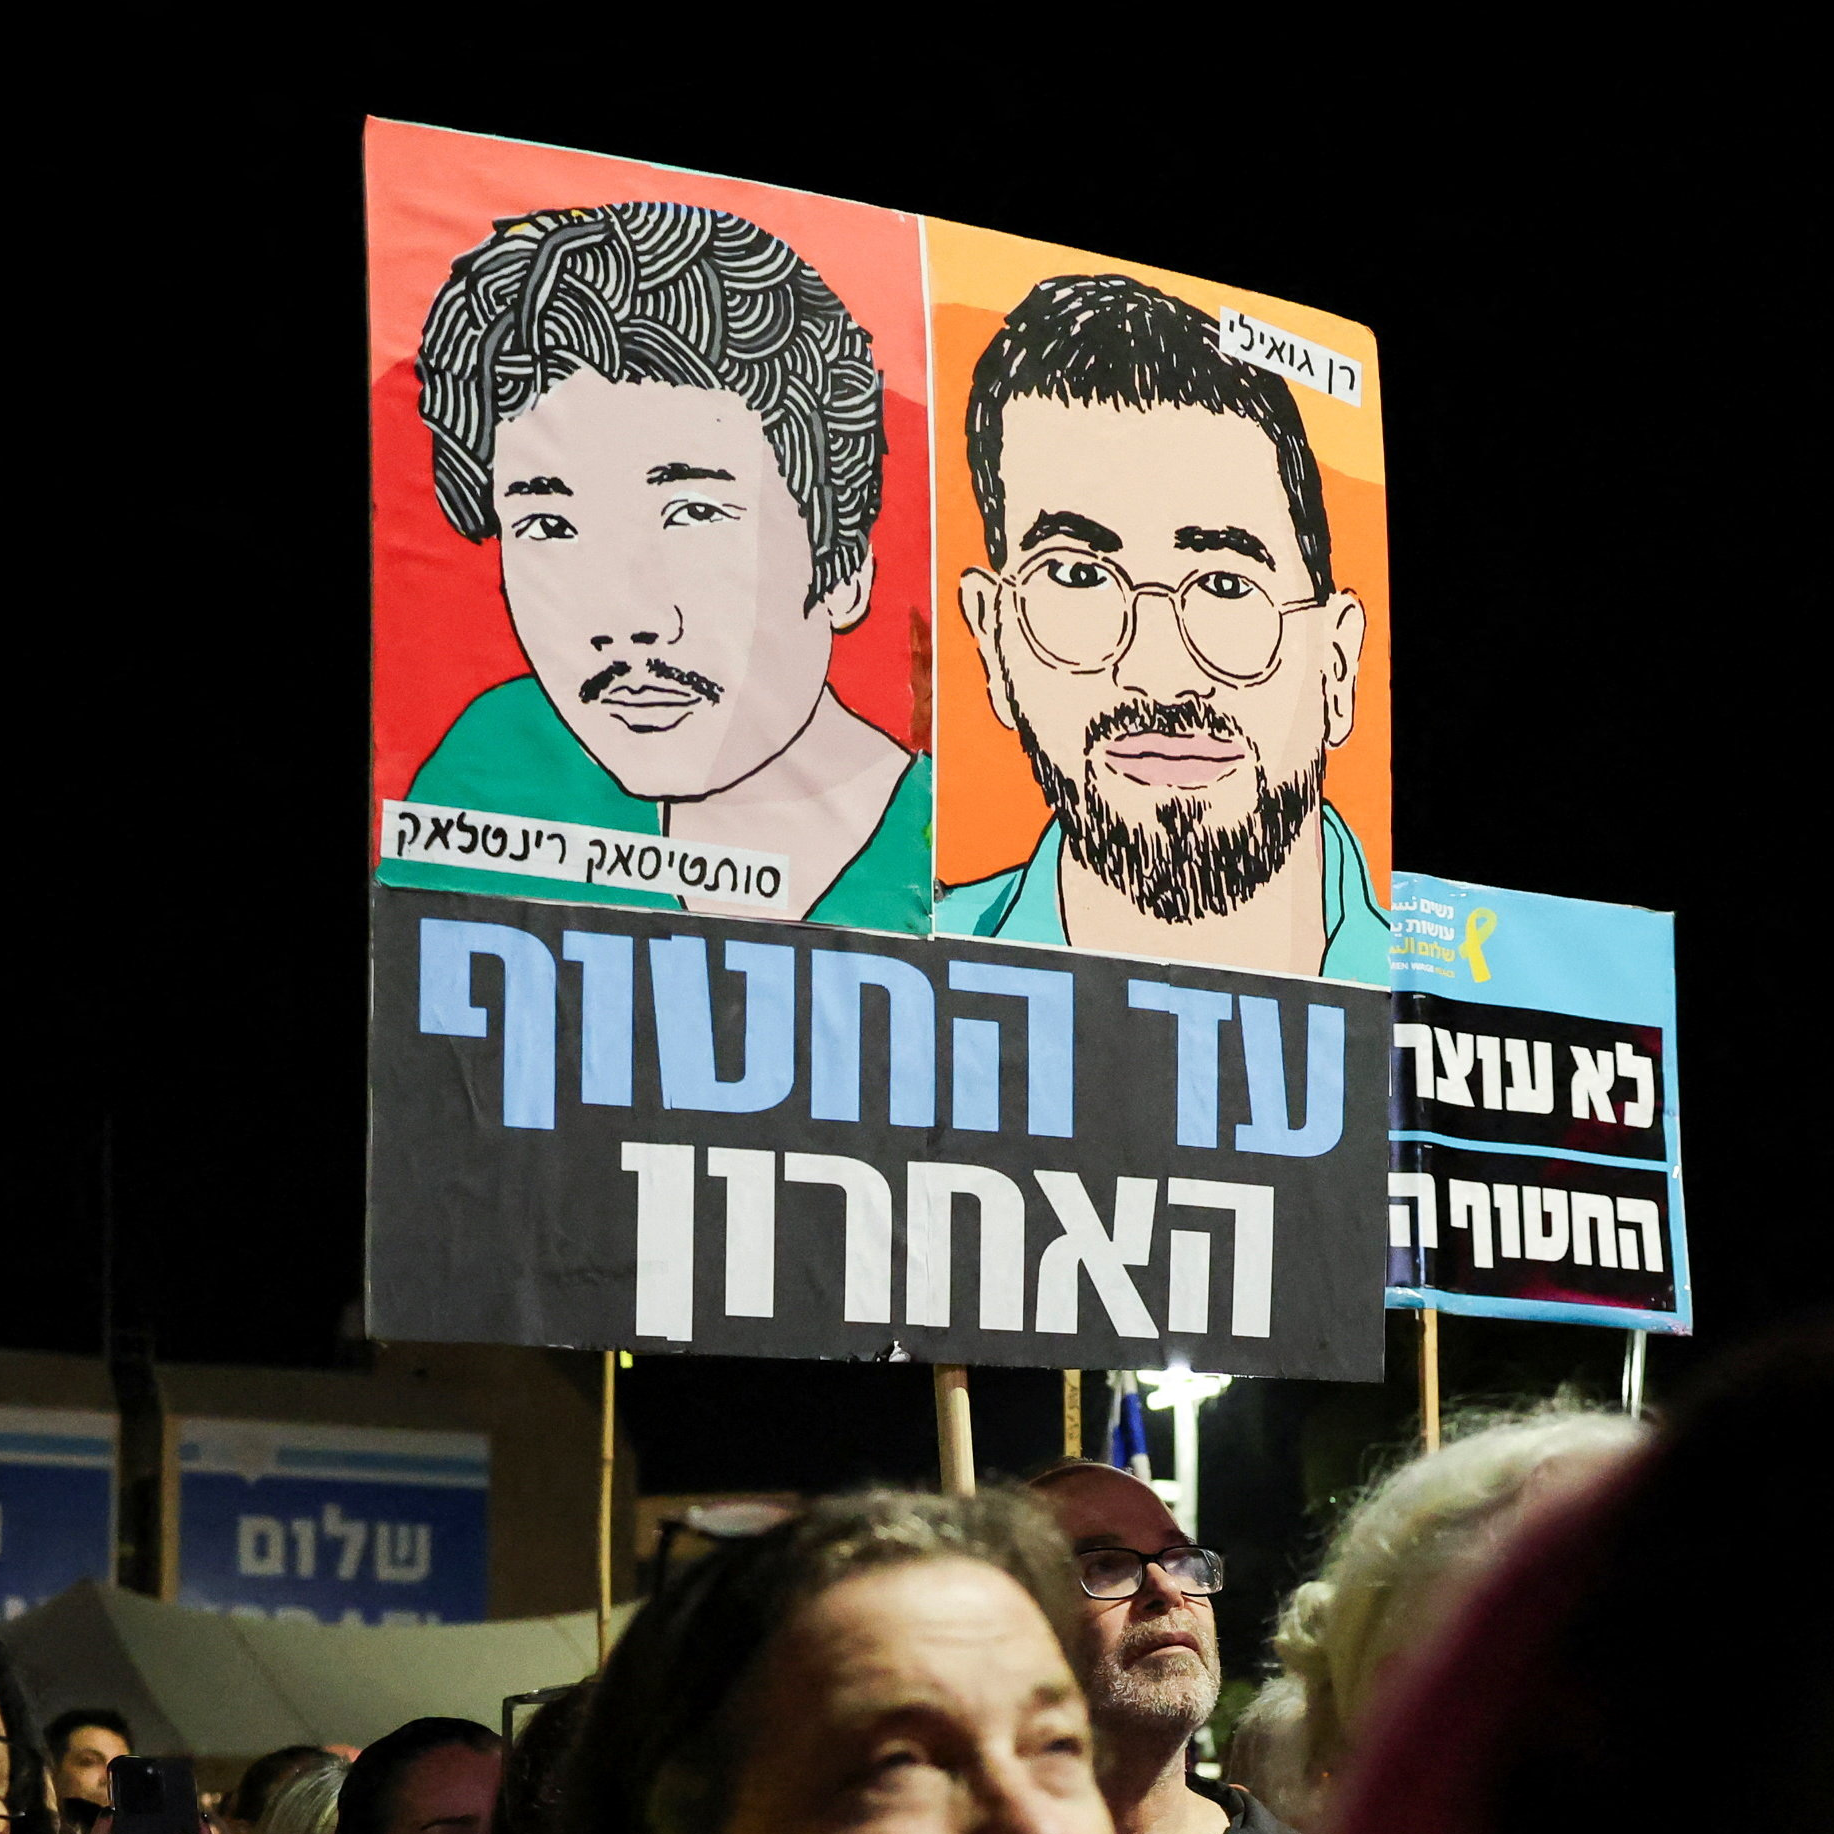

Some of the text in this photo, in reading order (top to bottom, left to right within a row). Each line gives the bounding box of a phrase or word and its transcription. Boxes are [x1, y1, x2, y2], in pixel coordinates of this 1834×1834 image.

[1228, 313, 1355, 395] רן גואילי
[397, 811, 781, 899] סותטיסאק רינטלאק
[1406, 918, 1455, 940] עושות
[1420, 898, 1455, 920] נשים
[1418, 941, 1456, 963] שלום
[419, 917, 1345, 1158] עד החטוף
[1389, 1023, 1655, 1129] לא עוצר
[620, 1141, 1275, 1342] האחרון
[1448, 1178, 1665, 1273] החטוף
[238, 1503, 431, 1583] שלום
